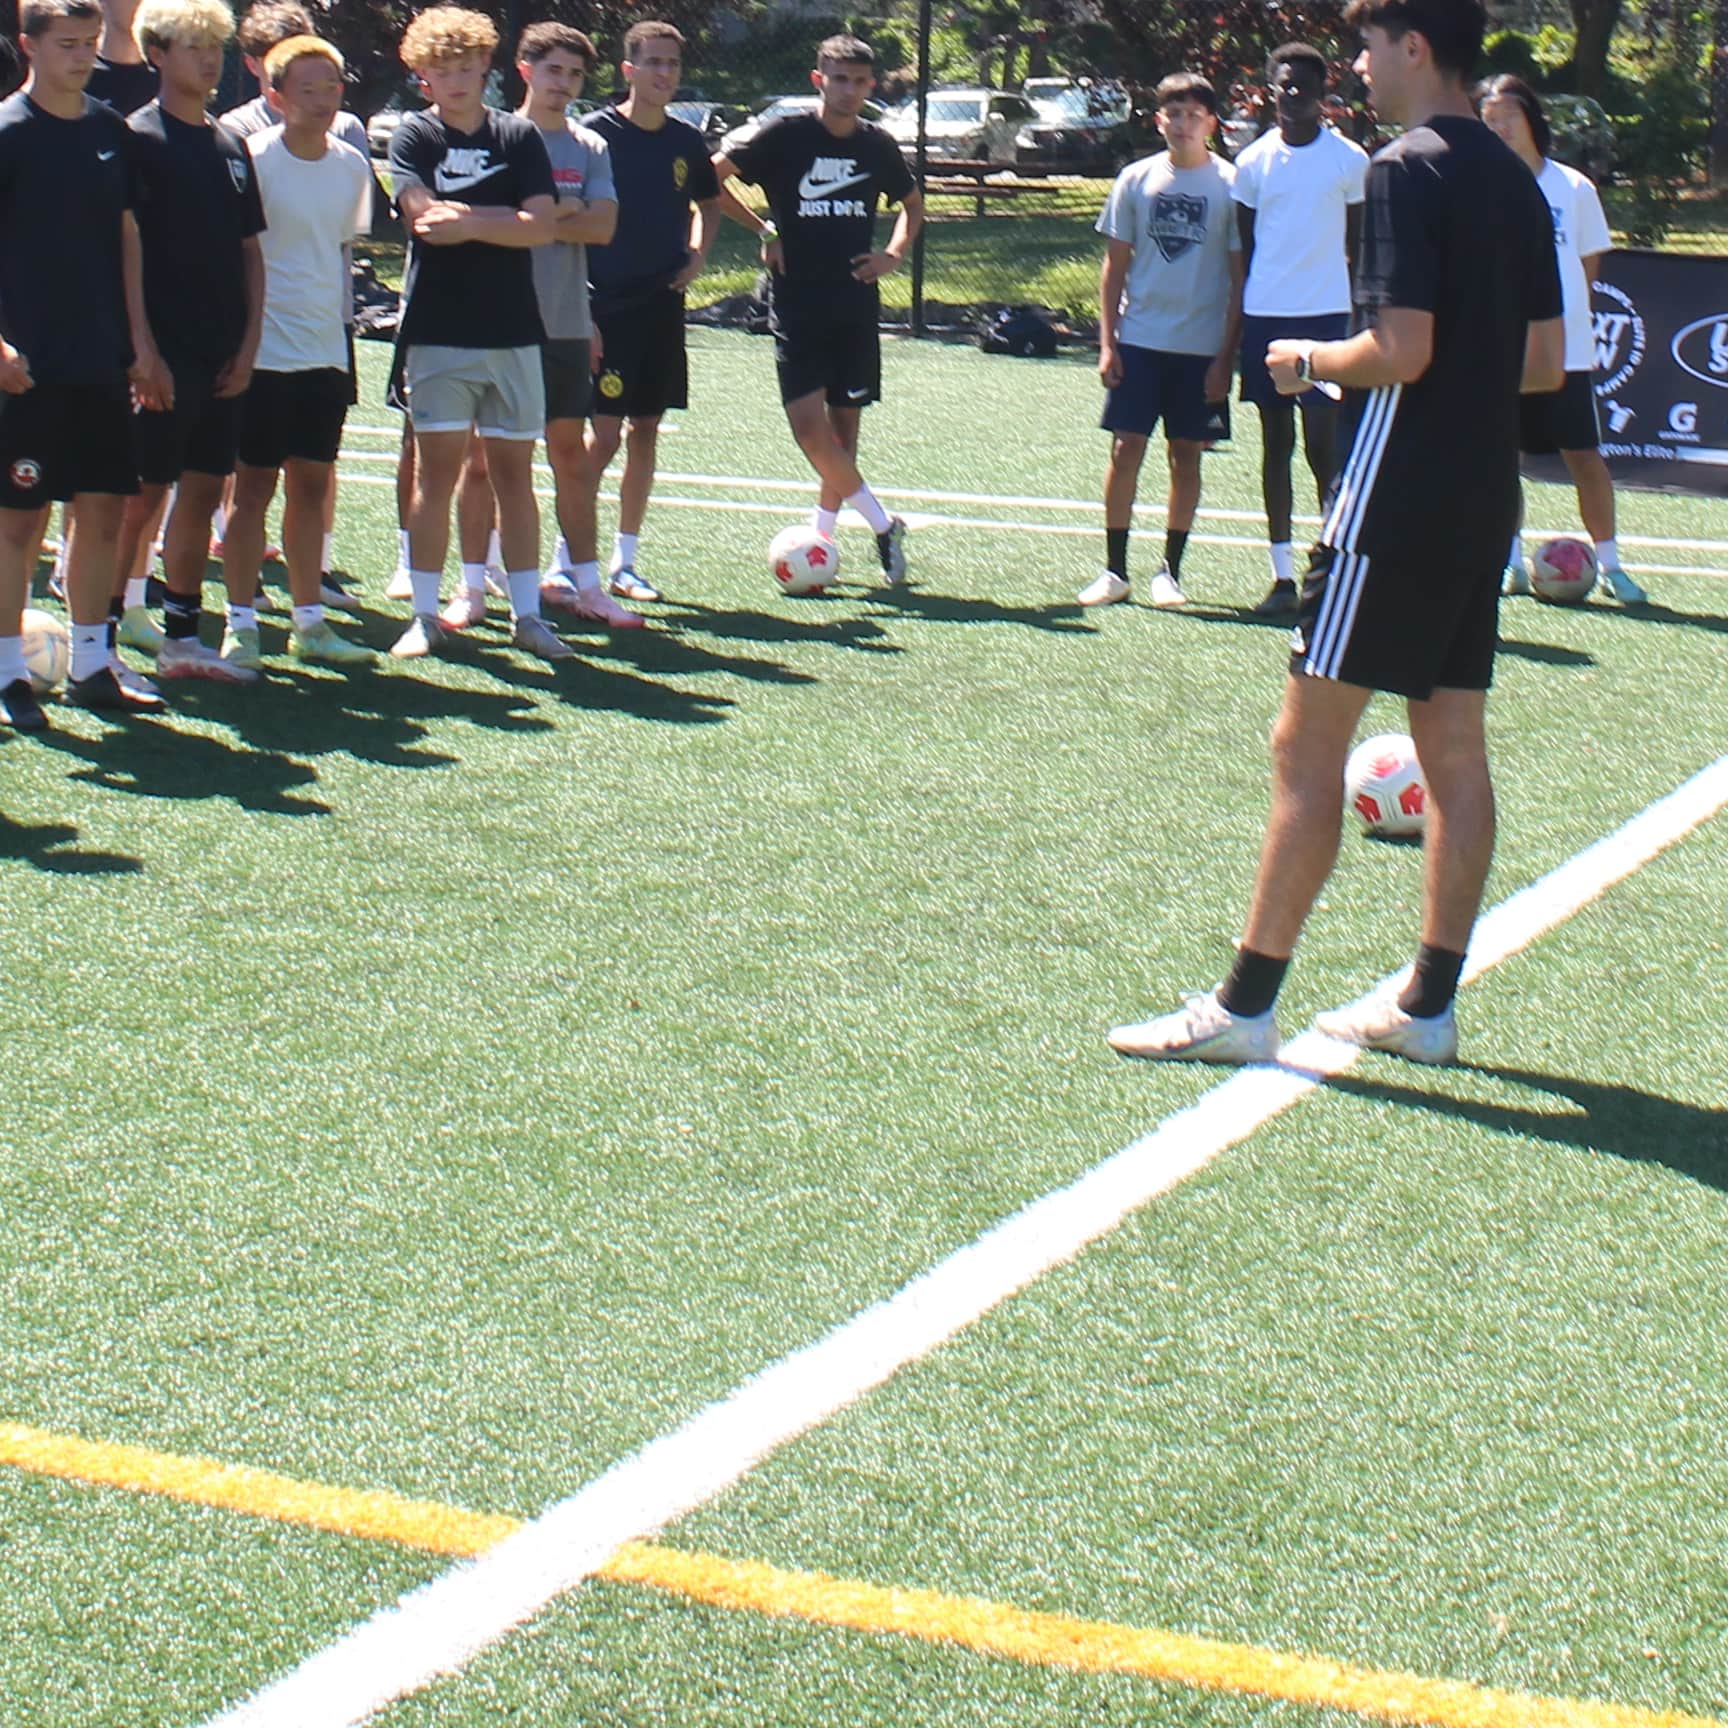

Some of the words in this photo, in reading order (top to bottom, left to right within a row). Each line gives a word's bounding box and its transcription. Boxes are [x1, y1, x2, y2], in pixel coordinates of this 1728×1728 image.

[444, 147, 491, 176] NIKE
[811, 156, 858, 182] NIKE
[797, 199, 832, 218] JUST
